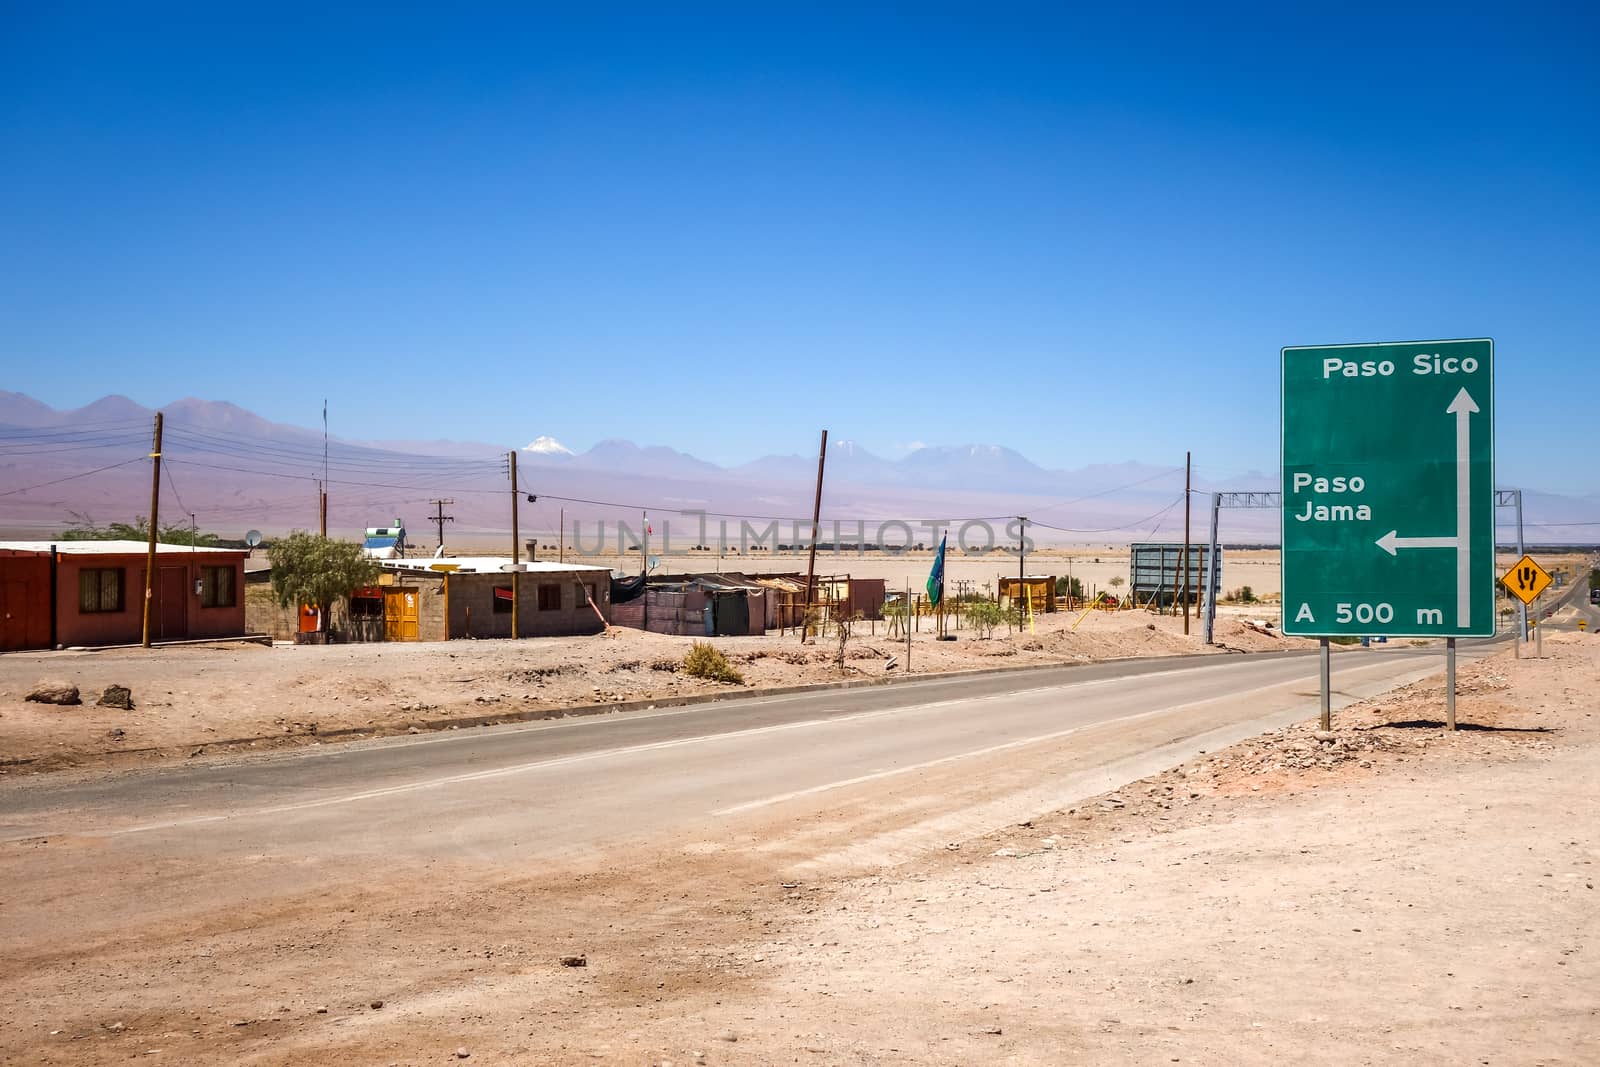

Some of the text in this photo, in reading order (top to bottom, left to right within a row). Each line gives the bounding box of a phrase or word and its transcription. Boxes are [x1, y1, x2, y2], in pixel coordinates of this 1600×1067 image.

[1323, 353, 1479, 378] Paso Sico
[1293, 472, 1365, 493] Paso
[1295, 501, 1372, 522] Jama
[1295, 602, 1443, 625] A 500 m
